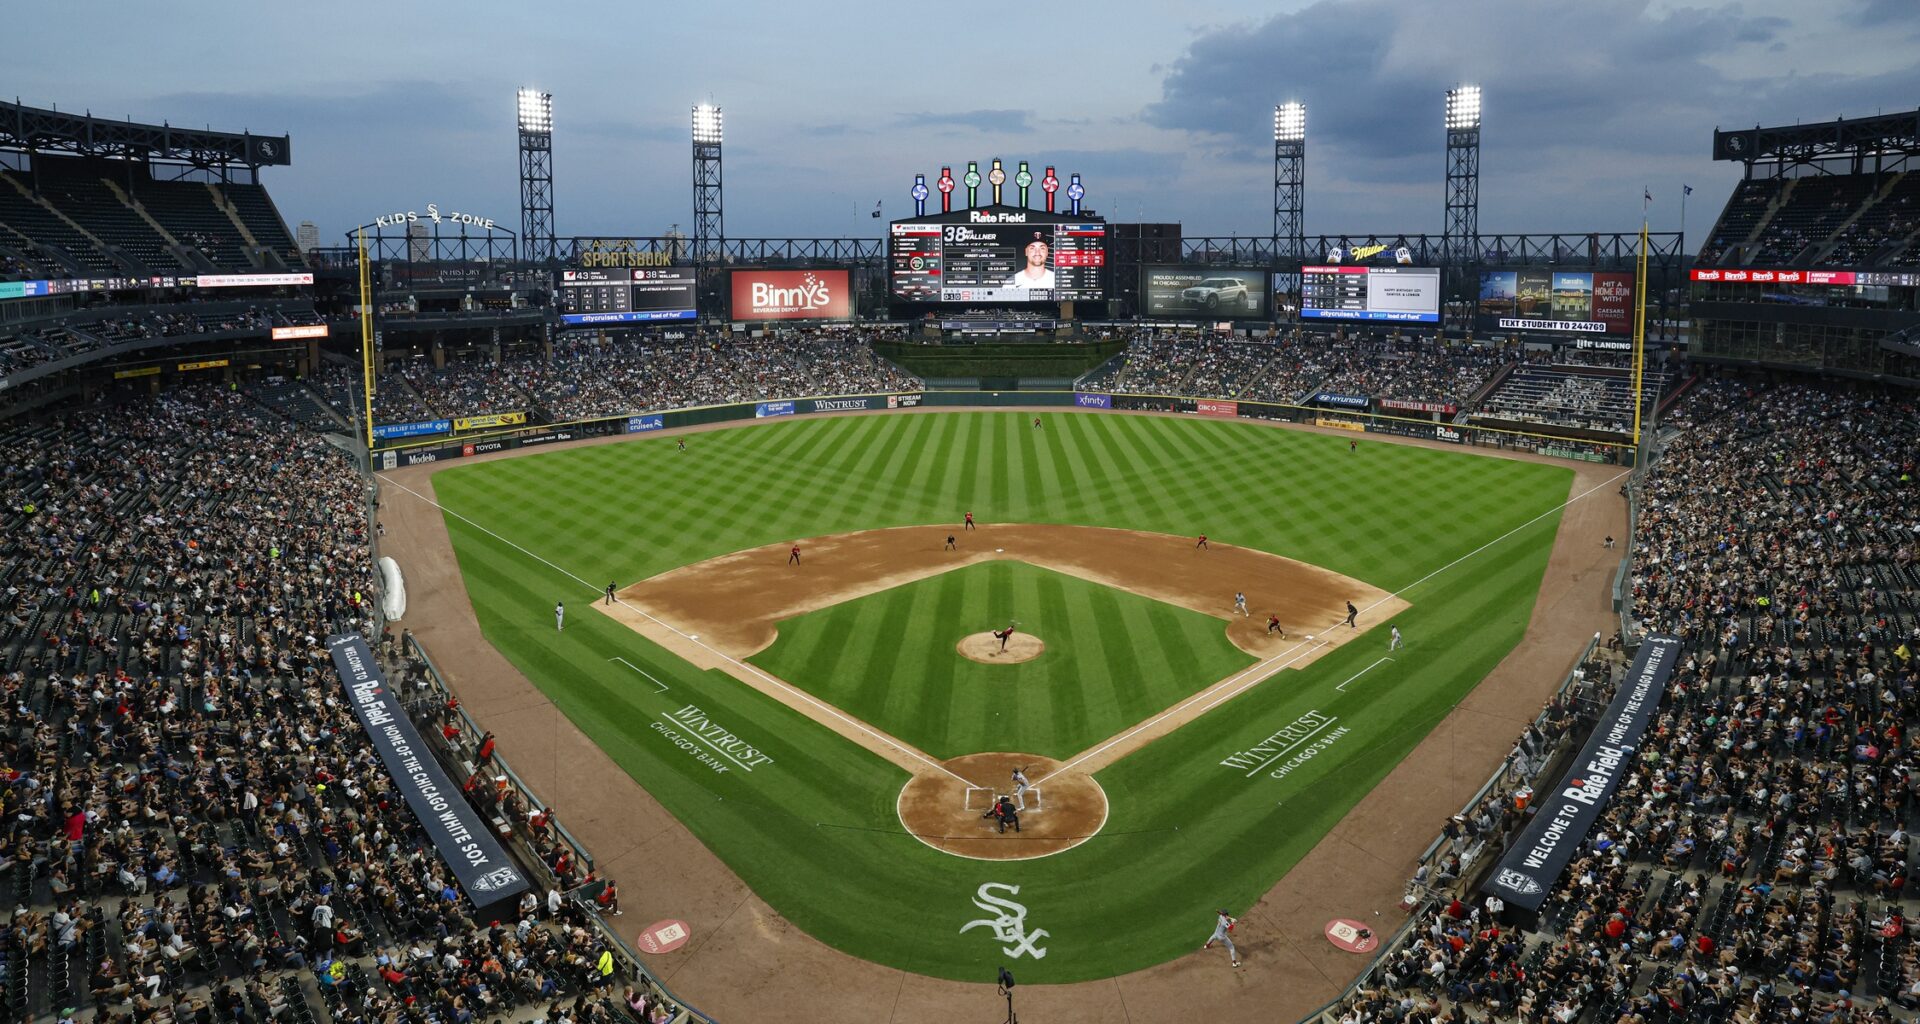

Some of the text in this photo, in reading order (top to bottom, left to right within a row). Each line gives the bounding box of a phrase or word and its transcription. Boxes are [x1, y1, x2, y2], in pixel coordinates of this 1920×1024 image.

[376, 211, 418, 228] KIDS
[451, 212, 494, 230] ZONE
[970, 211, 1026, 223] Rate Field
[944, 226, 966, 242] 38
[1350, 245, 1388, 261] Miller
[583, 252, 672, 267] SPORTSBOOK
[577, 272, 589, 280] 43
[646, 271, 656, 279] 38
[1594, 287, 1630, 297] HOME RUN
[1521, 320, 1557, 328] STUDENT
[1571, 322, 1605, 331] 244769
[664, 332, 685, 340] Modelo
[1595, 341, 1631, 350] LANDING
[815, 399, 867, 408] WINTRUST
[1079, 395, 1106, 407] xfinity
[1331, 396, 1364, 405] HYUNDAI
[1382, 400, 1446, 412] WHITTINGHAM MEATS
[388, 425, 409, 433] RELIEF
[630, 423, 653, 431] cruises
[1436, 426, 1460, 439] Rate
[475, 443, 501, 451] TOYOTA
[409, 453, 436, 465] Modelo
[673, 704, 775, 768] WINTRUST
[1219, 709, 1328, 770] WINTRUST
[650, 722, 730, 774] CHICAGO'S BANK
[1270, 725, 1351, 779] CHICAGO'S BANK
[344, 646, 489, 867] WELCOME TO Rate Field HOME OF THE CHICAGO WHITE SOX
[1523, 646, 1666, 869] WELCOME TO Rate Field HOME OF THE CHICAGO WHITE SOX
[643, 933, 658, 953] TOYOTA
